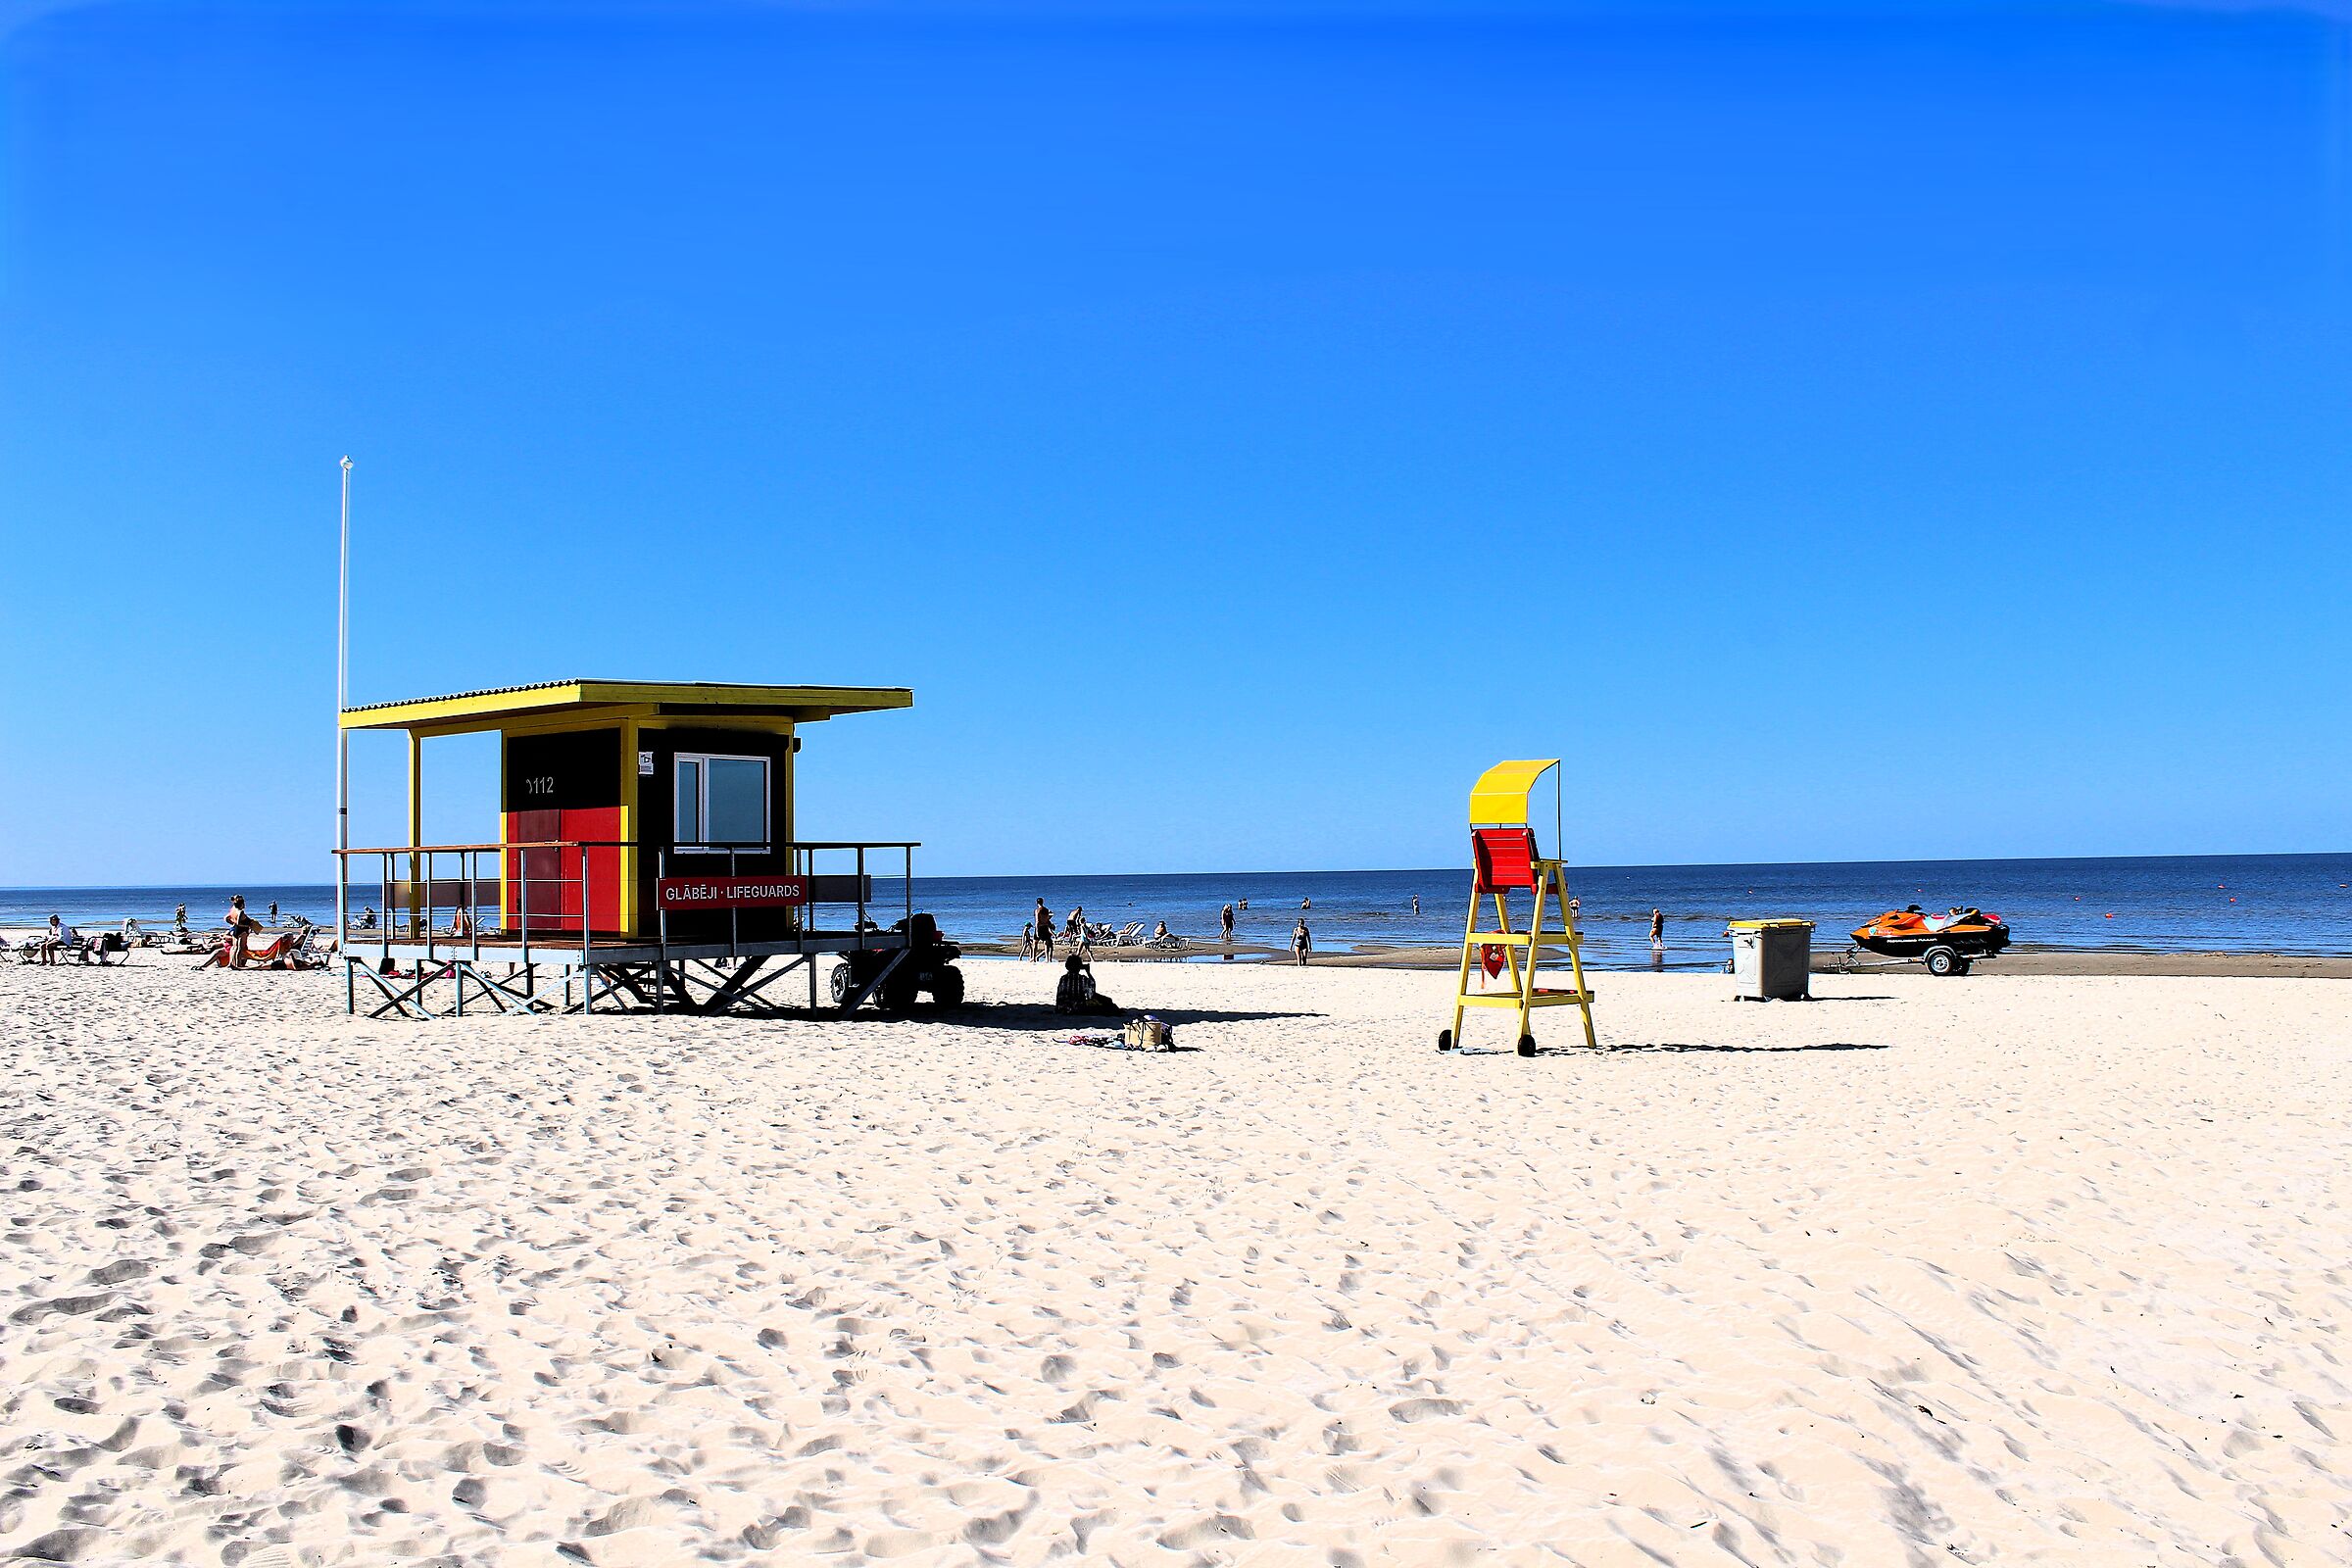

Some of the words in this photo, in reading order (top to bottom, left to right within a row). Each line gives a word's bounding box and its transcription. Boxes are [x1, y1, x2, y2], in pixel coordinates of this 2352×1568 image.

[533, 776, 554, 794] 112
[665, 884, 717, 901] GLĀBĒJI
[726, 884, 800, 899] LIFEGUARDS
